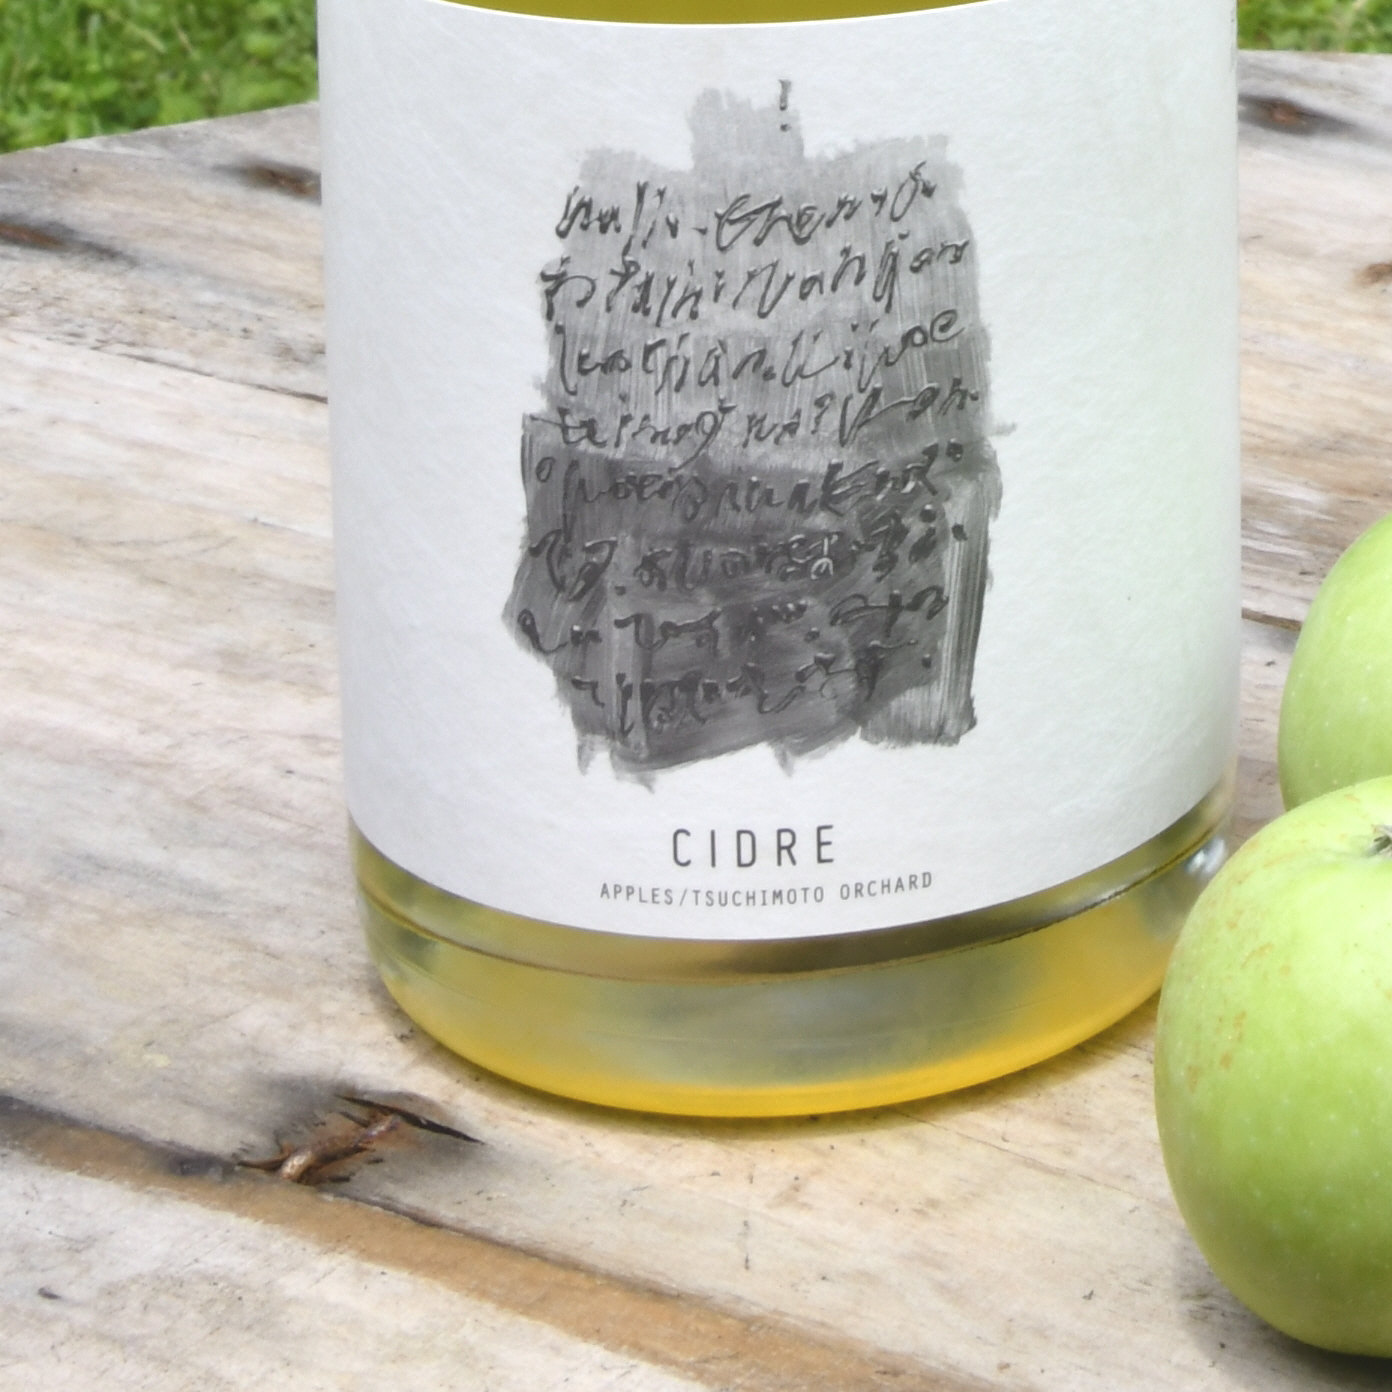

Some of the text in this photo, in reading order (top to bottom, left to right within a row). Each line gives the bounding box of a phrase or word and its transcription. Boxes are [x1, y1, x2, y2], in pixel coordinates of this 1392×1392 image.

[671, 823, 835, 869] CIDRE
[599, 871, 933, 908] APPLES/TSUCHIMOTO ORCHARD
